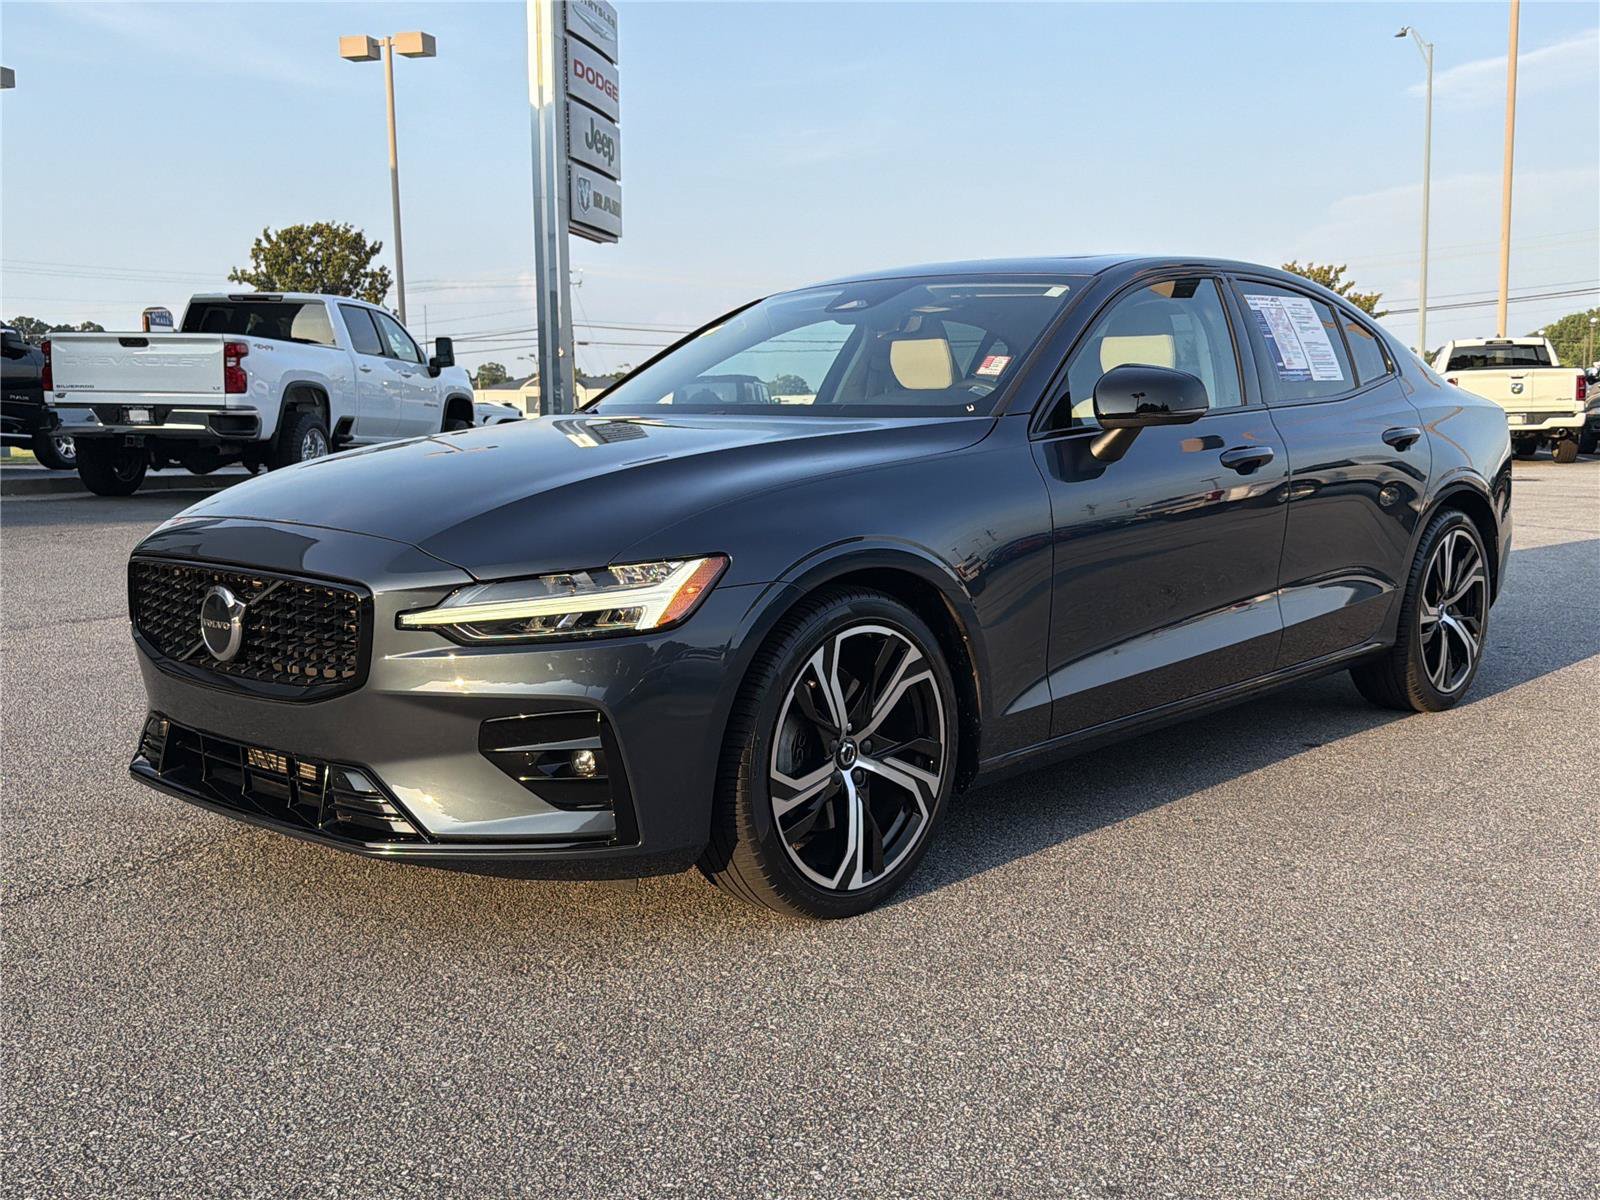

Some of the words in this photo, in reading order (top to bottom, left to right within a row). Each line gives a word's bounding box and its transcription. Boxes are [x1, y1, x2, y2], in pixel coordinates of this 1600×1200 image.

[573, 59, 618, 103] DODGE
[585, 117, 615, 166] Jeep
[593, 190, 621, 218] RAM
[62, 355, 212, 368] CHEVROLET
[203, 618, 231, 630] VOLVO
